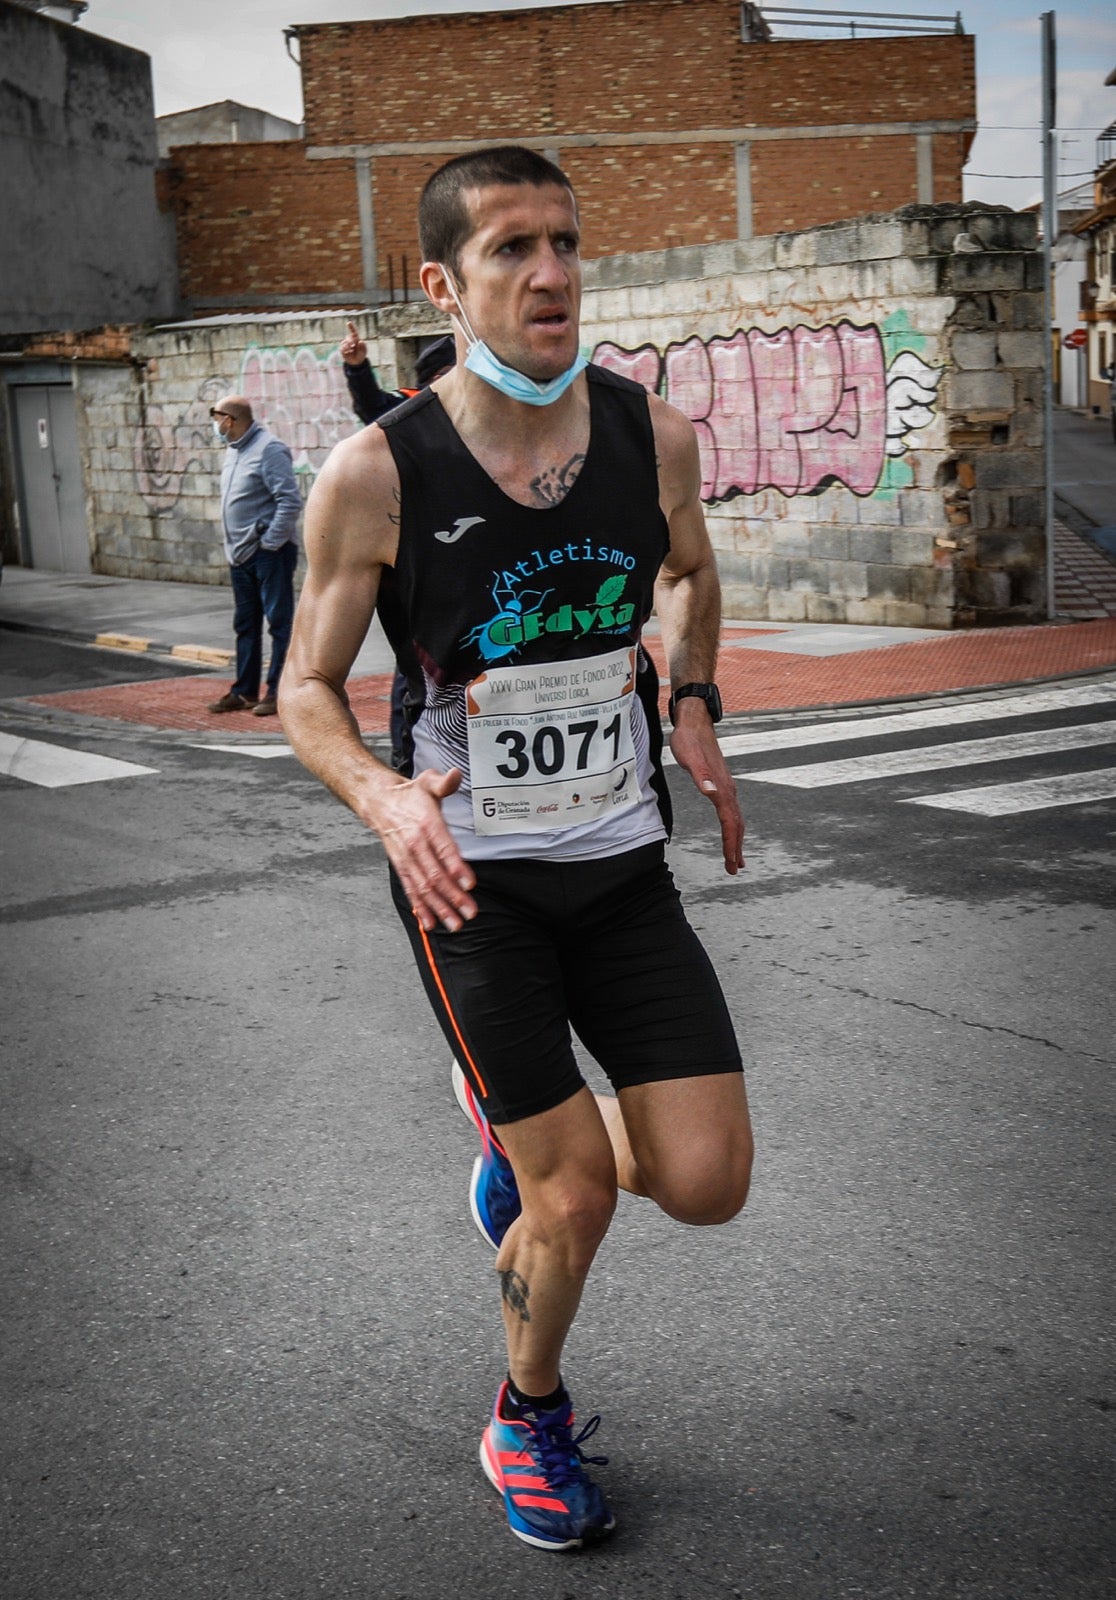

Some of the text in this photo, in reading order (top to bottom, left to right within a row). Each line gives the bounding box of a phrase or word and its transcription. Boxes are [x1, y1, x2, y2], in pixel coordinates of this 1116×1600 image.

[501, 538, 636, 589] Atletismo
[489, 678, 512, 694] XXXV
[607, 661, 624, 679] 2022
[495, 713, 621, 779] 3071
